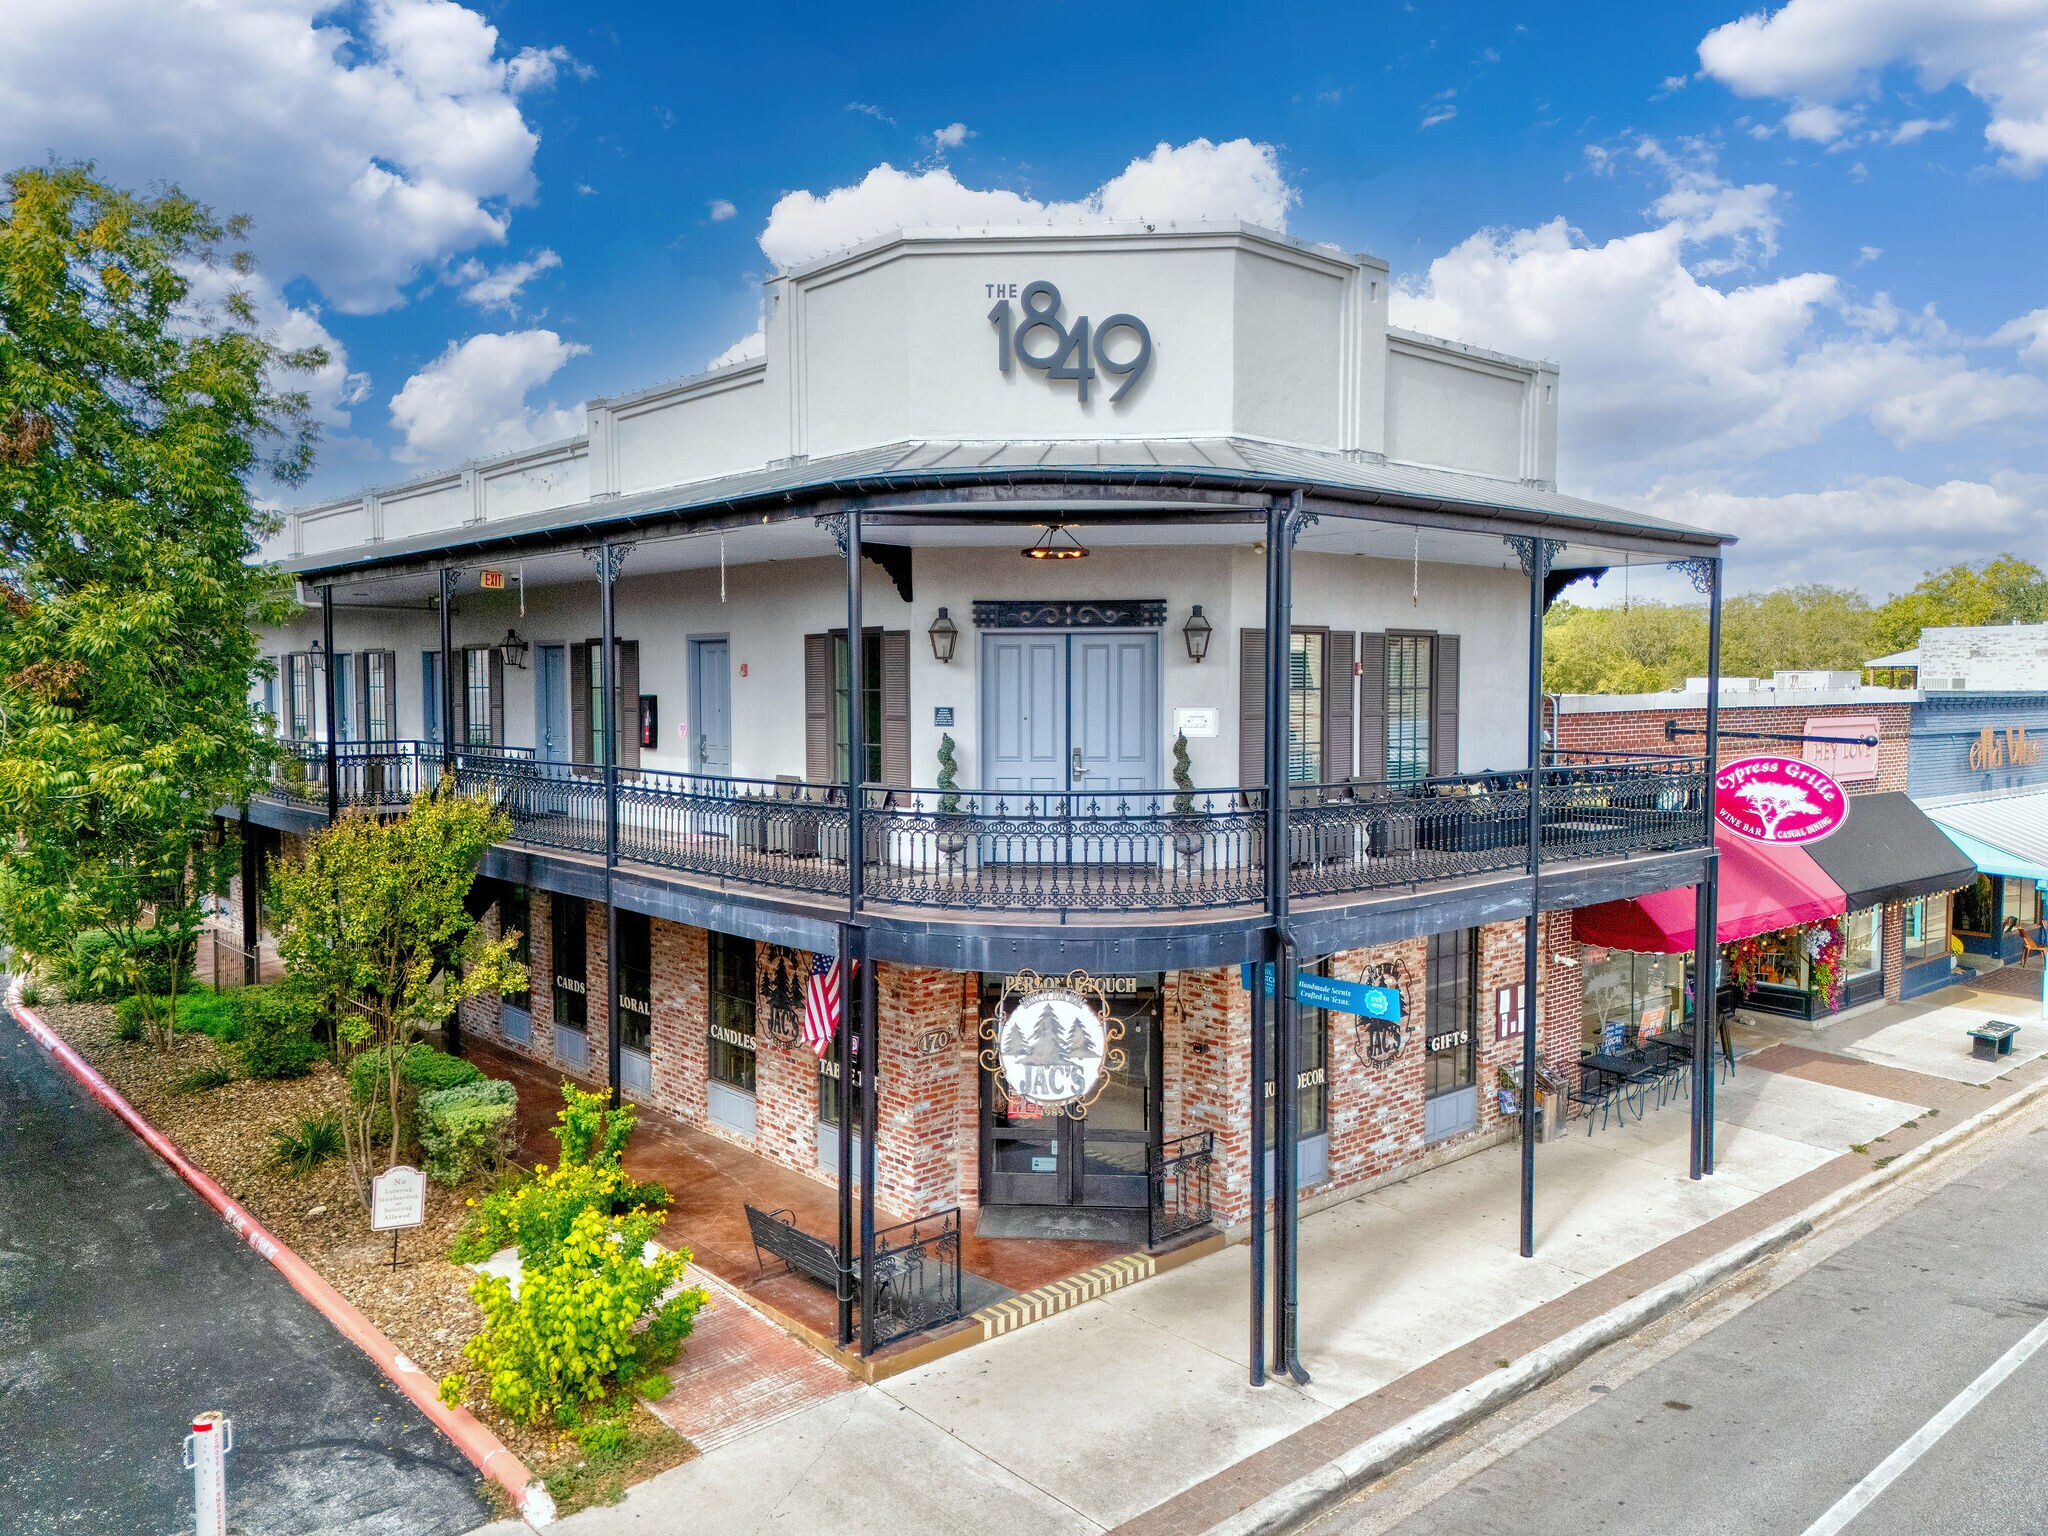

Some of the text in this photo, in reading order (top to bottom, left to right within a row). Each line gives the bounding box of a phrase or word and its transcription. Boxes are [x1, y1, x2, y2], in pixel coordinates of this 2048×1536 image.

[985, 284, 1018, 298] THE
[987, 280, 1151, 402] 1849
[485, 573, 502, 587] EXIT
[1814, 742, 1871, 760] HEY LOVE
[1716, 763, 1835, 802] Cypress Grille
[1719, 807, 1762, 837] WINE BAR
[1777, 816, 1833, 839] CASUAL DINING
[556, 975, 586, 994] CARDS
[1089, 977, 1137, 993] TOUCH
[1298, 981, 1352, 997] Handmade Scents
[619, 994, 651, 1016] LORAL
[1300, 990, 1323, 1001] Crafted
[1323, 993, 1330, 1001] in
[767, 1005, 799, 1040] JAC'S
[710, 1024, 757, 1050] CANDLES
[920, 1032, 948, 1052] 170
[1367, 1024, 1401, 1058] JAC'S
[1431, 1030, 1469, 1051] GIFTS
[1019, 1065, 1086, 1095] JAC'S
[393, 1178, 407, 1186] No
